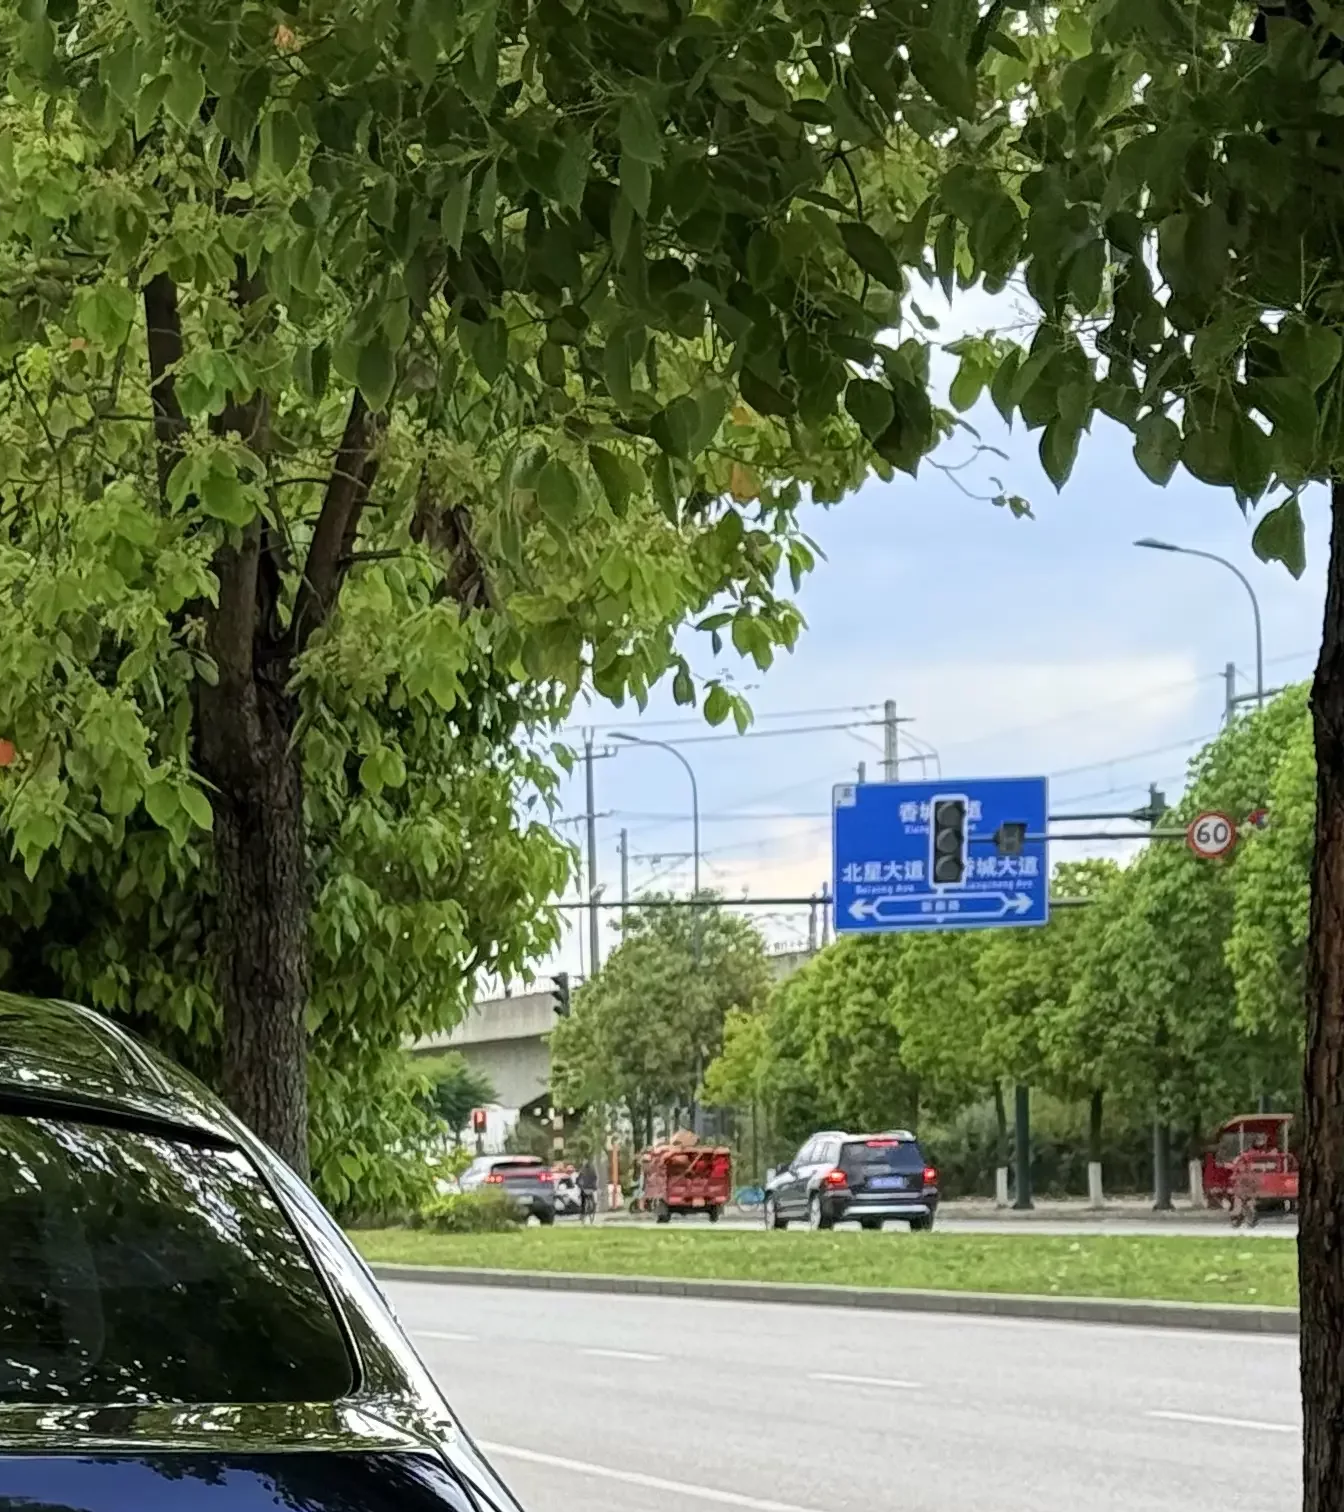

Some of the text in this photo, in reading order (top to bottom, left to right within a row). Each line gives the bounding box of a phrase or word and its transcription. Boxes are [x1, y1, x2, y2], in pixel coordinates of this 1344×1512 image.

[1197, 822, 1228, 844] 60
[842, 860, 924, 883] 北星大道
